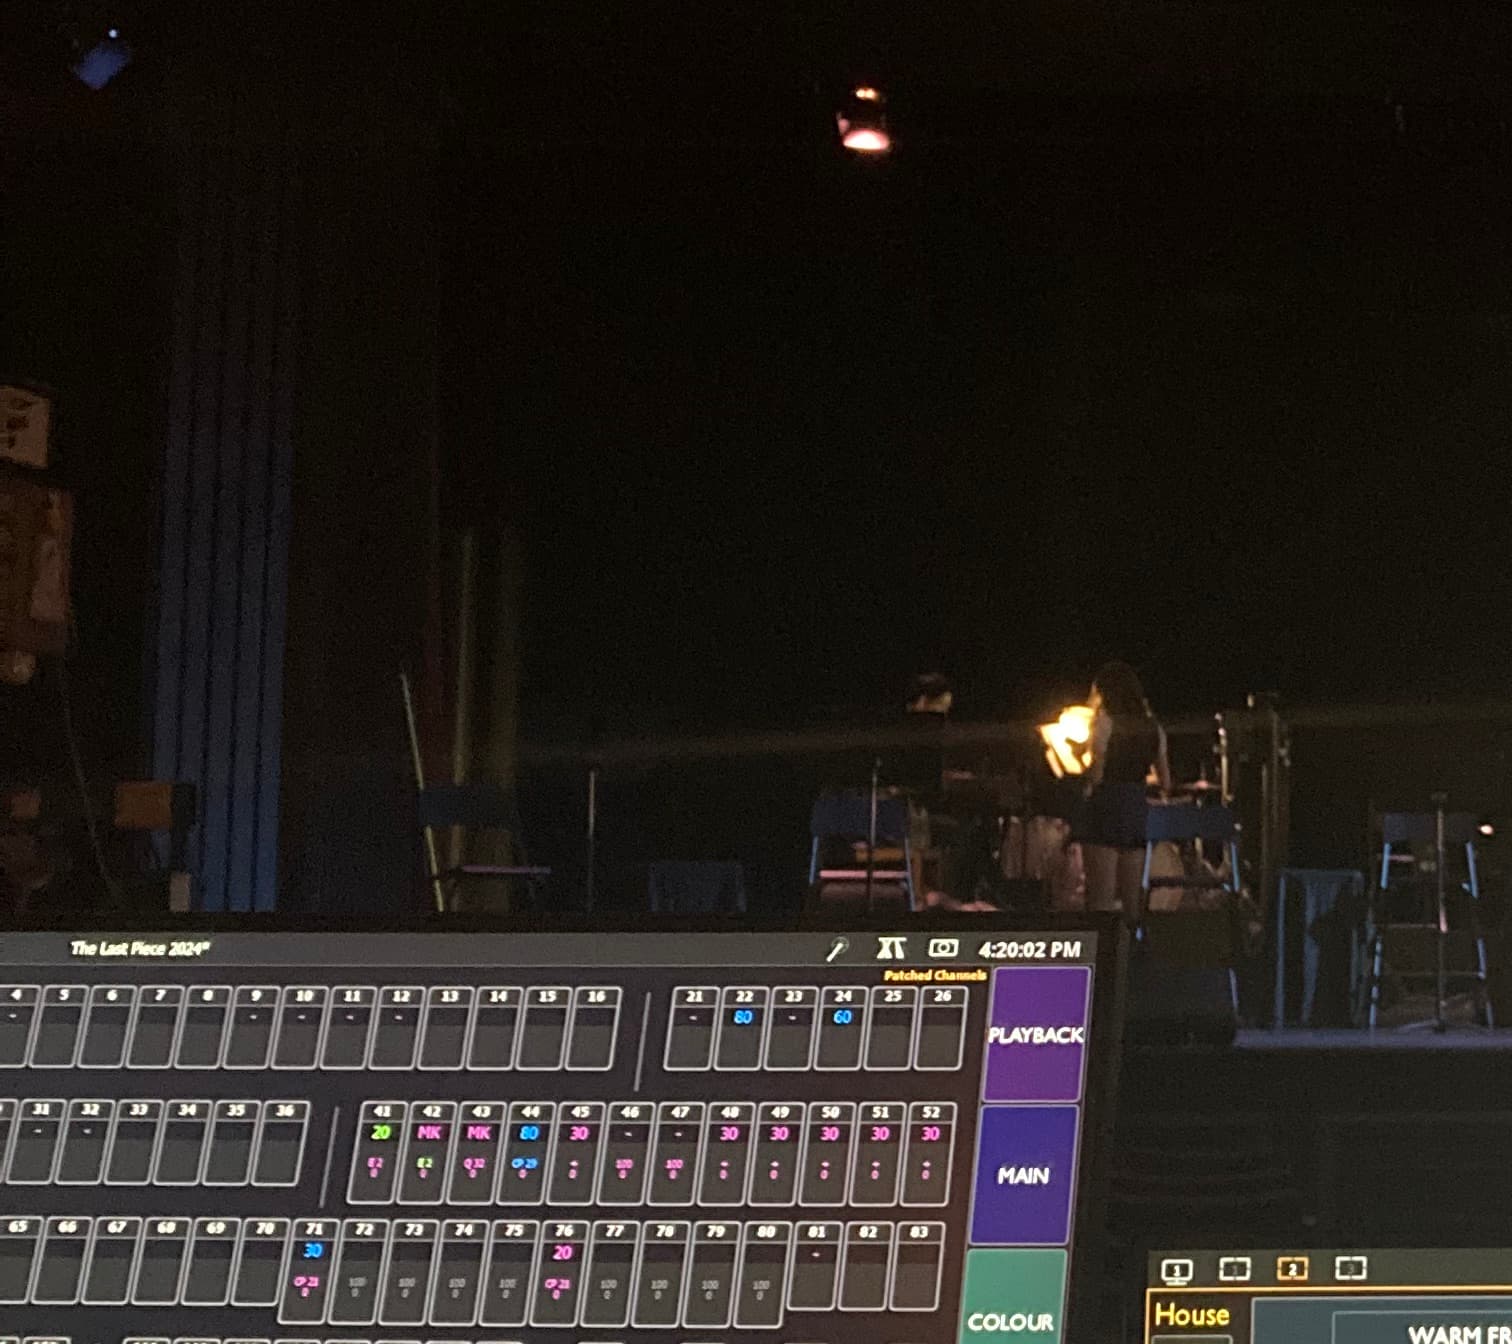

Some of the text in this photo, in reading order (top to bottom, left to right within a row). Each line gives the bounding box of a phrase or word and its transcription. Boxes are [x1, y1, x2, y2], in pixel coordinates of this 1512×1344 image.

[71, 941, 97, 955] The
[100, 942, 128, 956] Last
[131, 941, 166, 955] Piece
[979, 941, 1081, 958] 4:20:02 PM
[884, 969, 987, 981] Patched Channels
[736, 991, 754, 1002] 22
[835, 990, 852, 1002] 24
[935, 990, 951, 1001] 26
[988, 1027, 1085, 1044] PLAYBACK
[374, 1106, 391, 1117] 41
[423, 1106, 441, 1117] 42
[472, 1106, 491, 1117] 43
[522, 1106, 540, 1117] 44
[822, 1106, 840, 1118] 50
[923, 1106, 940, 1118] 52
[371, 1125, 391, 1139] 20
[418, 1126, 441, 1139] MK
[468, 1126, 491, 1139] MK
[520, 1126, 539, 1140] 80
[821, 1127, 839, 1140] 30
[998, 1167, 1049, 1184] MAIN
[306, 1223, 322, 1235] 71
[304, 1243, 323, 1257] 30
[1156, 1302, 1229, 1326] House
[968, 1313, 1053, 1331] COLOUR
